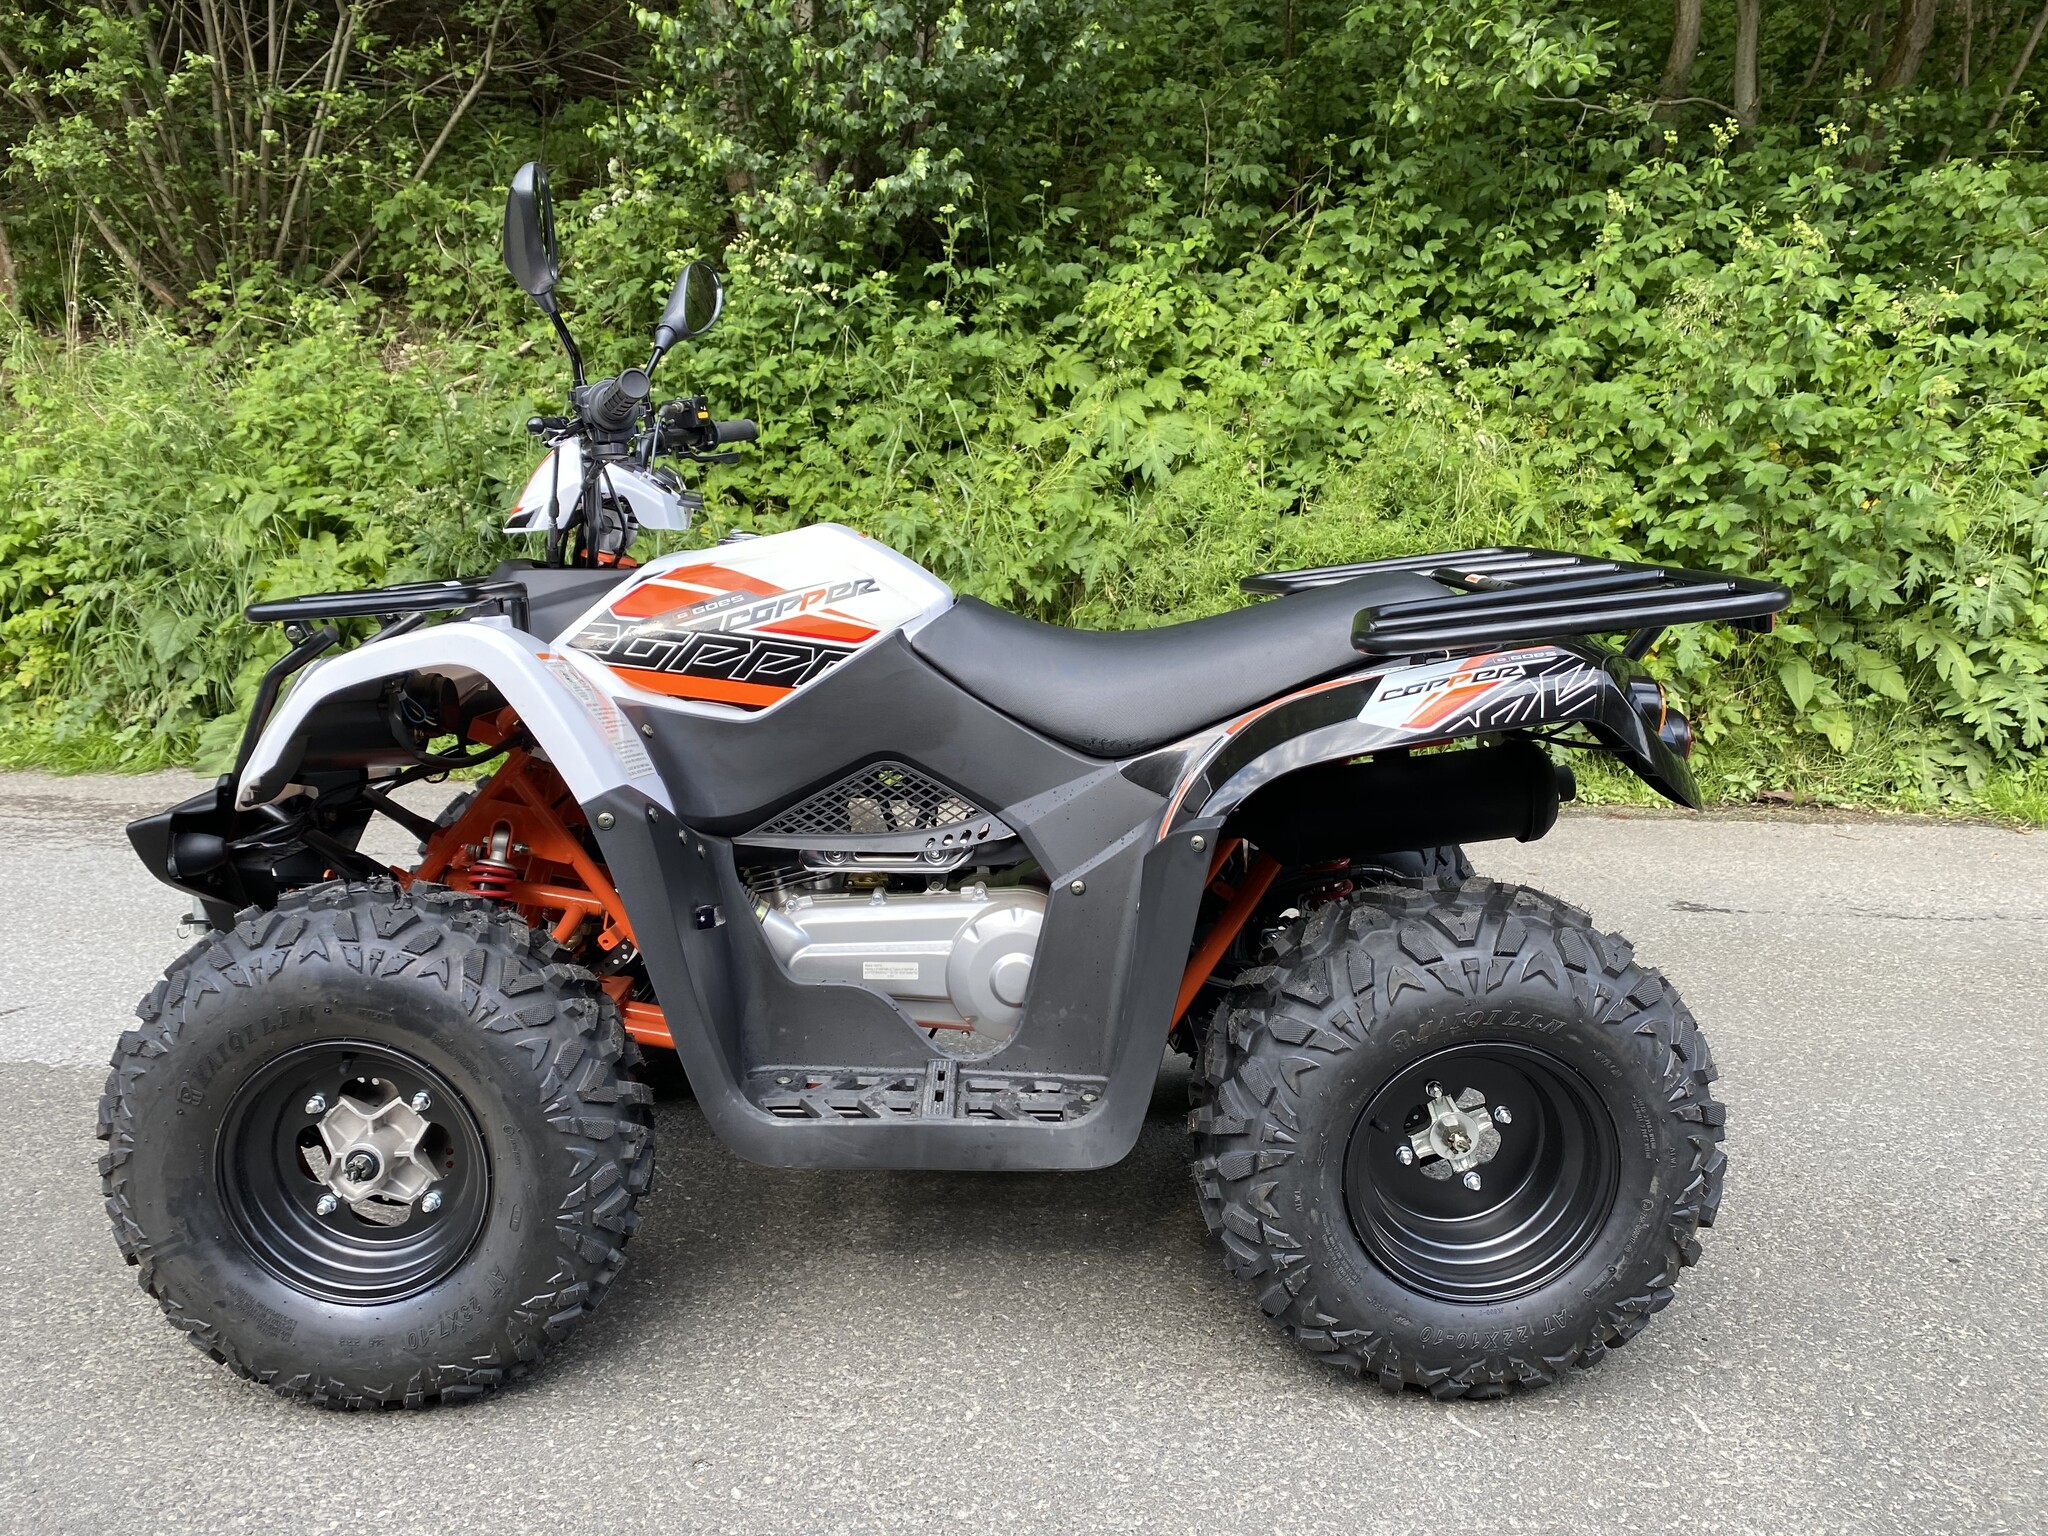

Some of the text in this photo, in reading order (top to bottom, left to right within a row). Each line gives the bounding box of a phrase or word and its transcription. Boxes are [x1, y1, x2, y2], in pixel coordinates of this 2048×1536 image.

[692, 594, 745, 616] GOES
[724, 578, 880, 632] COPPER
[1380, 666, 1523, 702] COPPER
[486, 1265, 507, 1297] AT
[1420, 1308, 1567, 1349] AT 22X10-10
